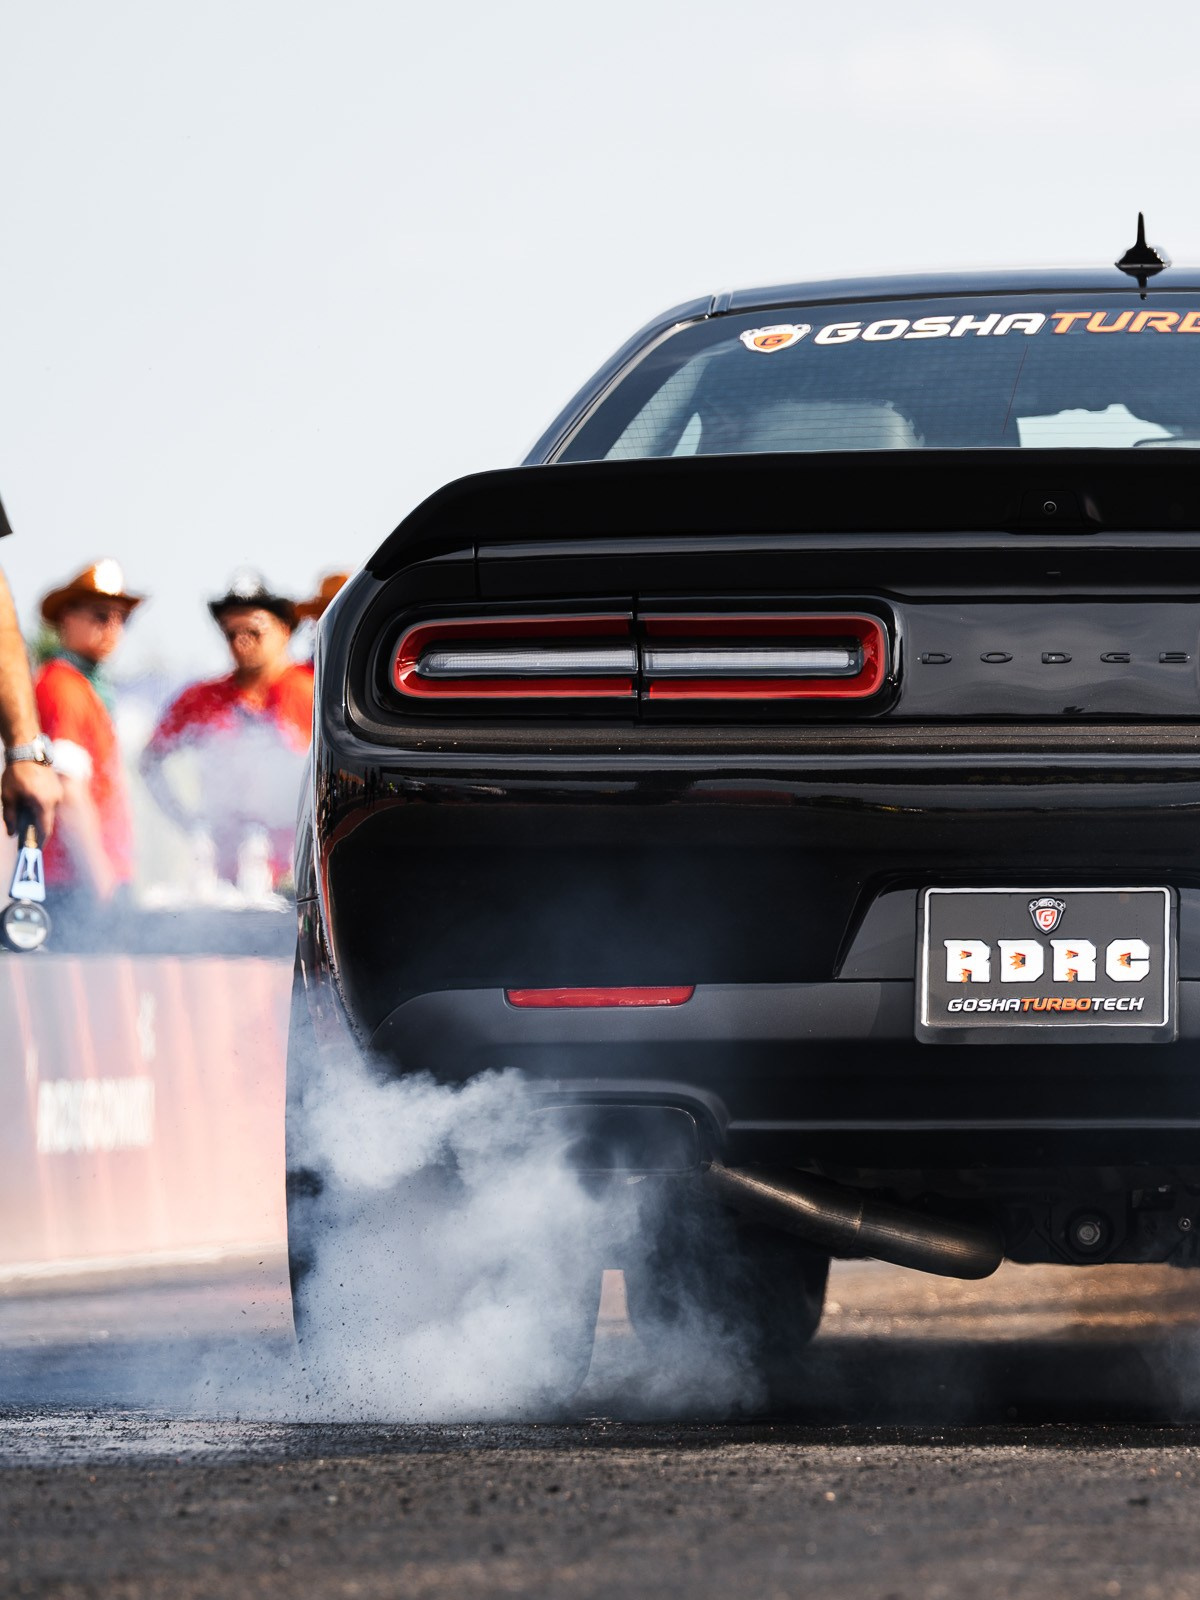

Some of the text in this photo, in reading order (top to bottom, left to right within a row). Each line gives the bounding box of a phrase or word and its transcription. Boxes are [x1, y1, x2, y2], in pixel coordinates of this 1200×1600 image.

[921, 651, 1188, 665] DODGE
[943, 938, 1150, 982] RDRC
[947, 996, 1145, 1013] GOSHATURBOTECH
